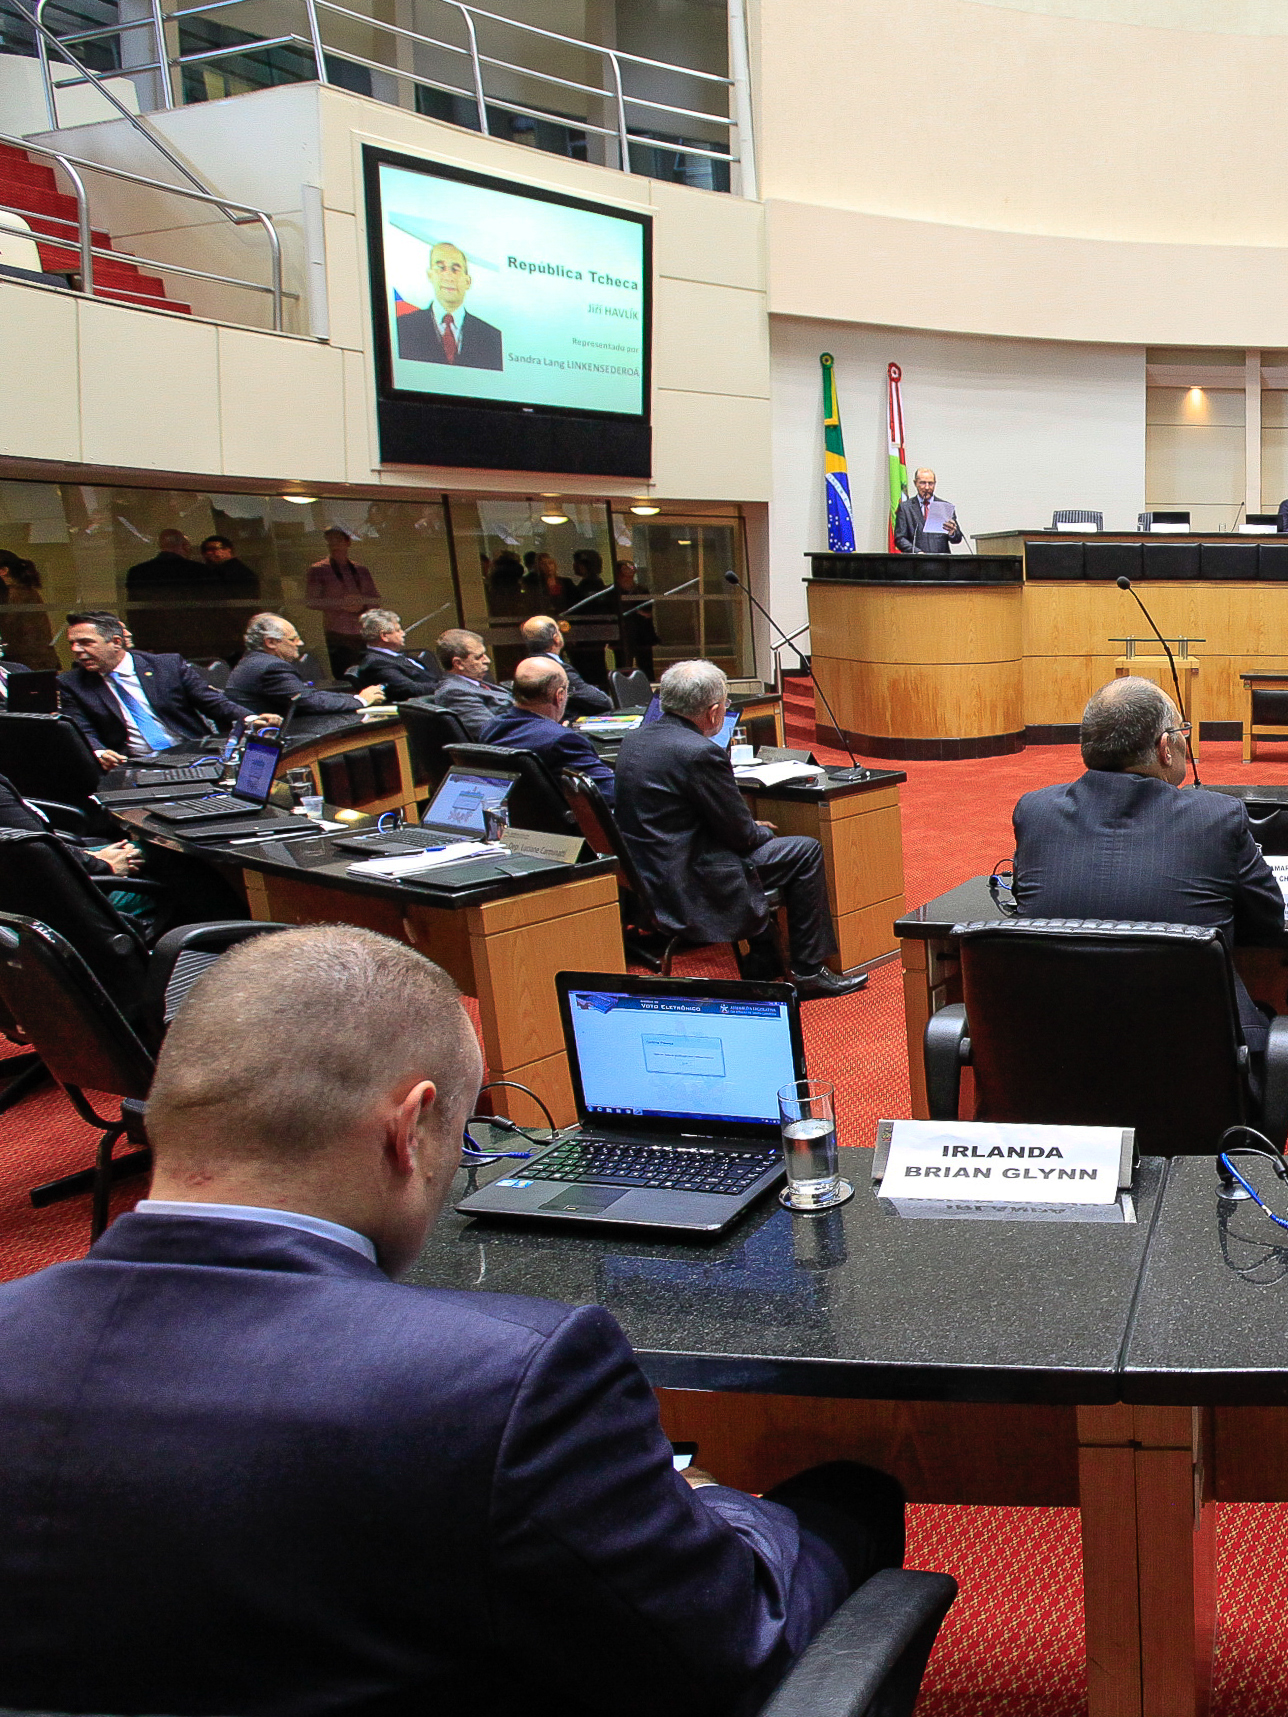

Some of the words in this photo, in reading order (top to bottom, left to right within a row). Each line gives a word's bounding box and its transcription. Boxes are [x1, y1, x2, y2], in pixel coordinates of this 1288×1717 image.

[507, 256, 583, 281] República
[588, 270, 639, 290] Tcheca
[572, 337, 625, 352] Representado
[508, 352, 542, 365] Sandra
[543, 357, 565, 370] Lang
[942, 1145, 1064, 1159] IRLANDA
[904, 1165, 992, 1179] BRIAN
[1001, 1167, 1098, 1181] GLYNN
